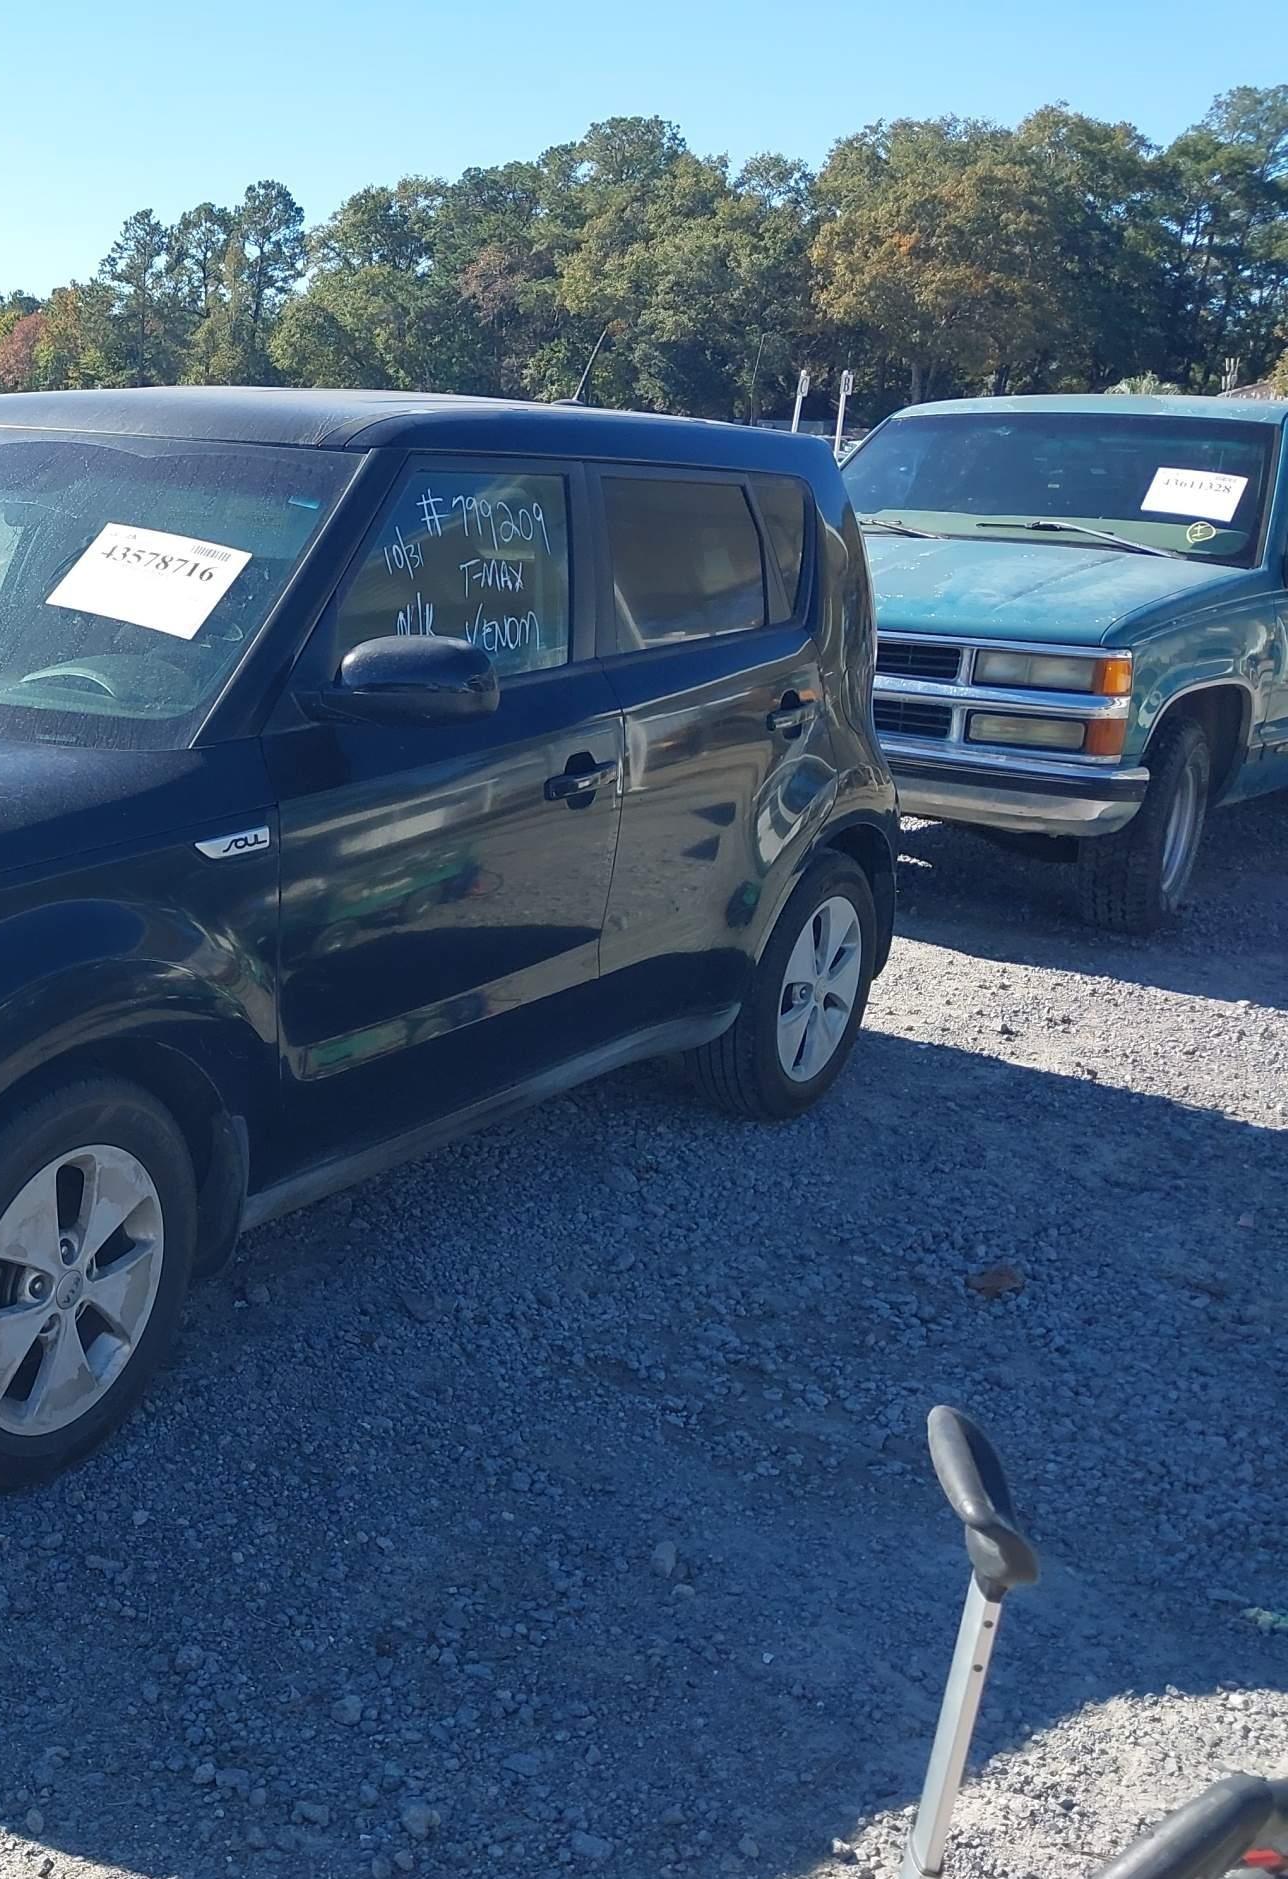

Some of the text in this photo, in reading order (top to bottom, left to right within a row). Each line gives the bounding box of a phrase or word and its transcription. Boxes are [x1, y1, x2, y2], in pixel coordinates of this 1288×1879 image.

[101, 545, 218, 582] 43578716
[383, 526, 424, 580] 10/31
[459, 559, 524, 598] T-MAX
[465, 603, 540, 655] VENOM
